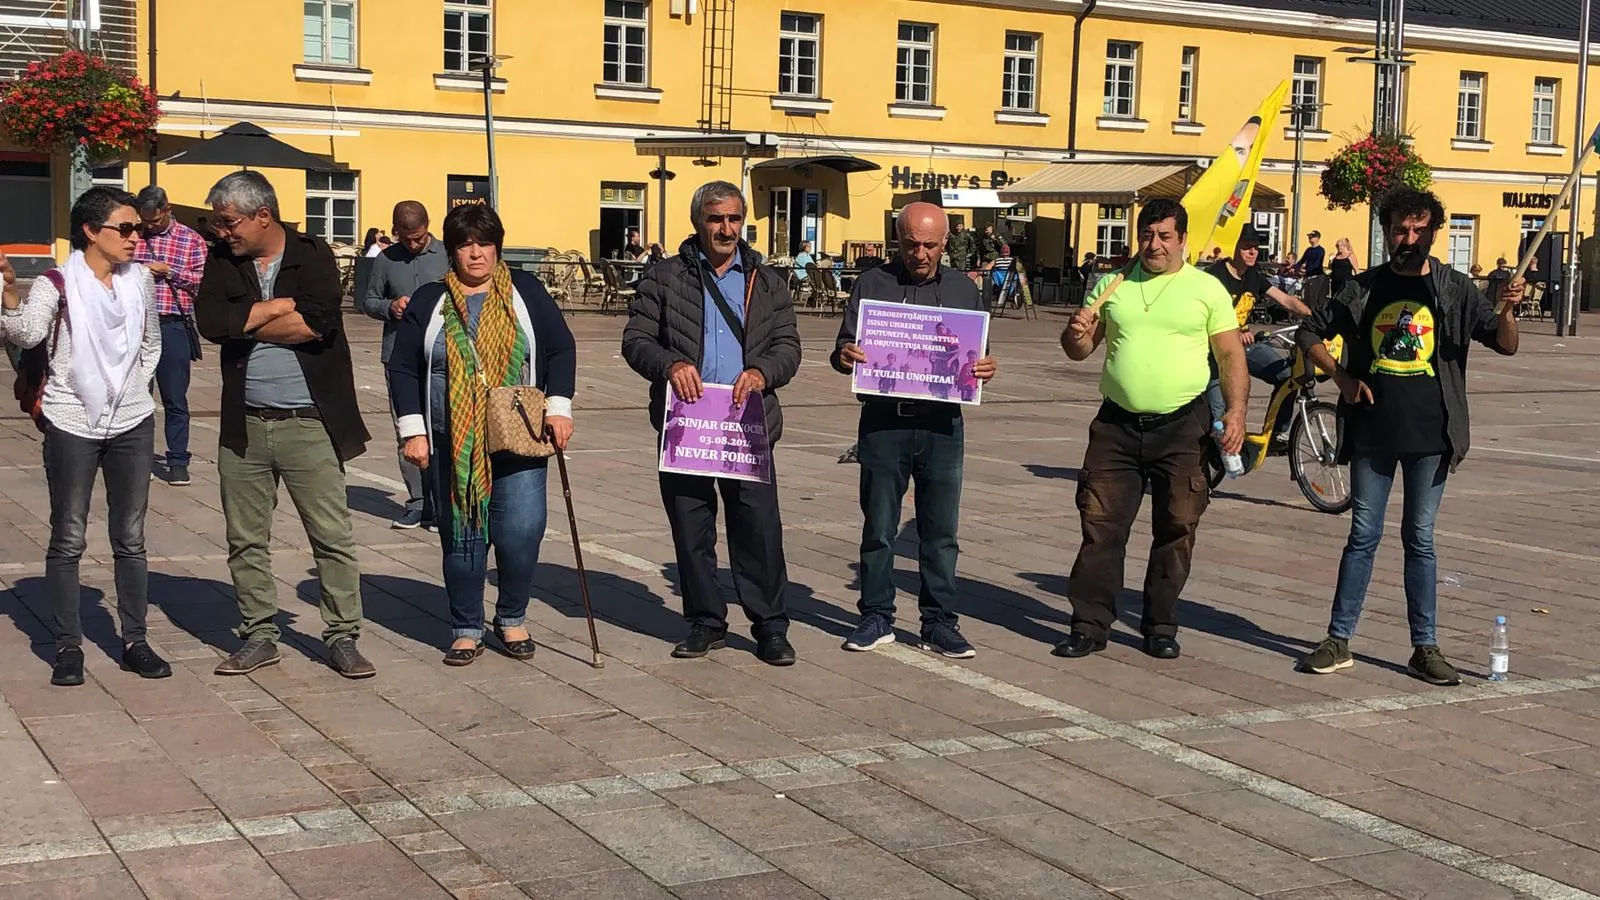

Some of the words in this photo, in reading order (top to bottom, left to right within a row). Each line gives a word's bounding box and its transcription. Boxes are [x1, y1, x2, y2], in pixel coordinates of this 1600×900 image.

[868, 309, 943, 322] TERRORISTIJÄRJESTÖ
[867, 319, 889, 328] ISISIN
[889, 320, 924, 330] UHREIKSI
[865, 328, 911, 340] JOUTUNEITA,
[912, 334, 960, 344] RAISKATTUJA
[873, 339, 921, 350] ORJUTETTUJA
[862, 368, 873, 376] EI
[873, 369, 905, 379] TULISI
[906, 373, 955, 384] UNOHTAA!
[677, 416, 718, 431] SINJAR
[674, 446, 718, 460] NEVER
